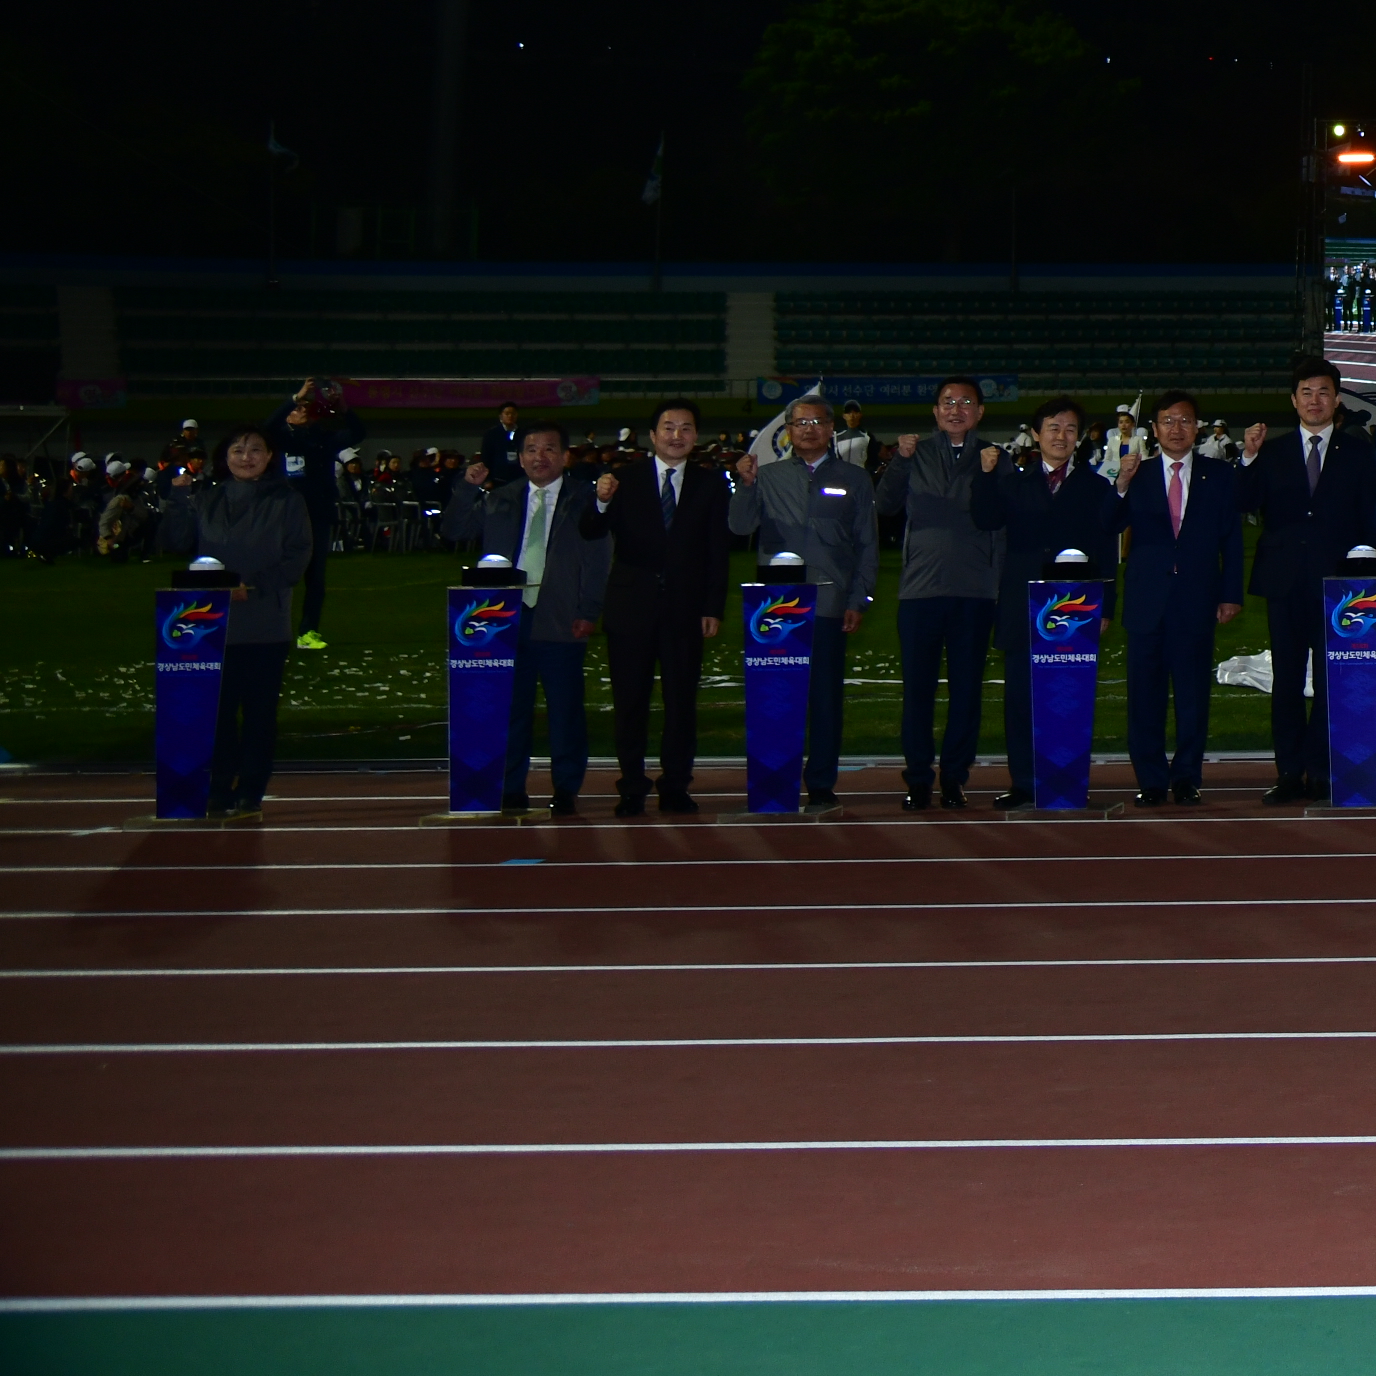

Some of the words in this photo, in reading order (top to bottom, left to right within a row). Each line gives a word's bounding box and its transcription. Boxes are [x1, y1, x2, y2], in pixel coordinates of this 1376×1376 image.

[745, 656, 810, 666] 경상남도민체육대회
[1032, 653, 1097, 663] 경상남도민체육대회
[157, 662, 221, 672] 경상남도민체육대회
[450, 658, 514, 669] 경상남도민체육대회
